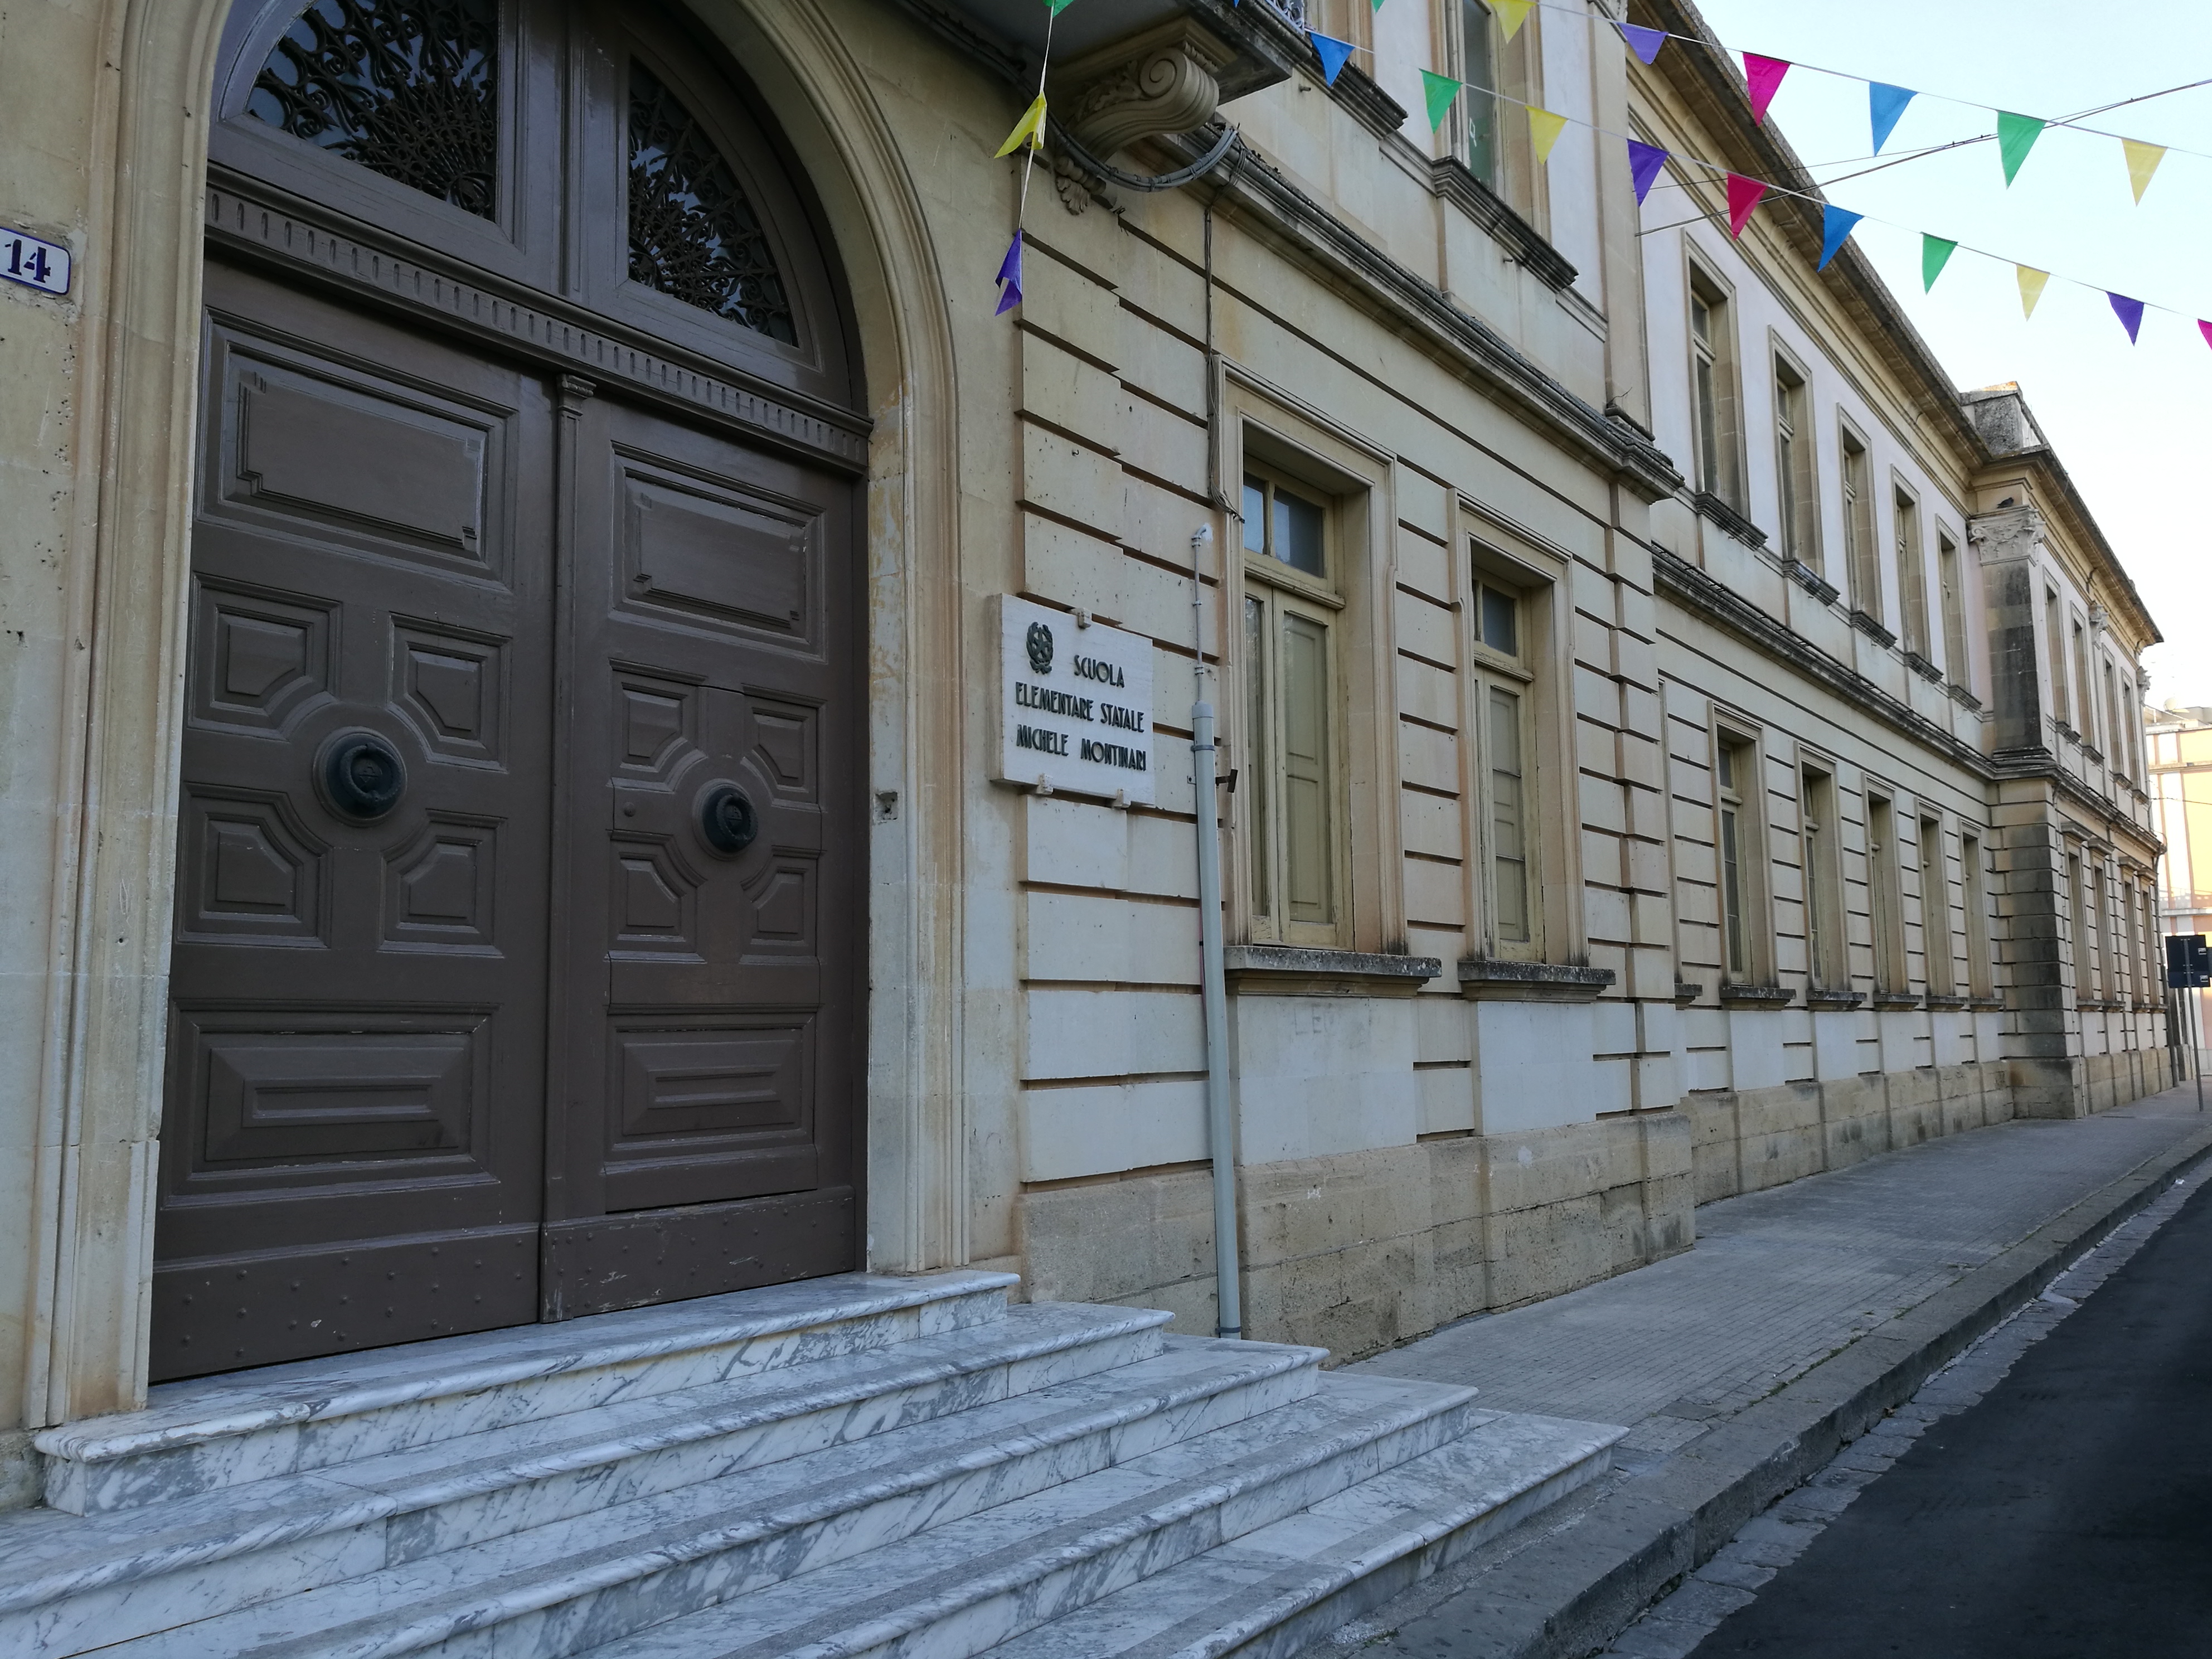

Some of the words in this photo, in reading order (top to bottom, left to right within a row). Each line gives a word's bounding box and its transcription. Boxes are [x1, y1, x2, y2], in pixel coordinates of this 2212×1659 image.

[5, 239, 51, 283] 14
[1074, 654, 1125, 688] SCUOLA
[1015, 681, 1094, 721] ELEMENTARE
[1100, 702, 1145, 733] STATALE
[1016, 724, 1069, 756] MICHELE
[1080, 738, 1147, 772] MONTINARI
